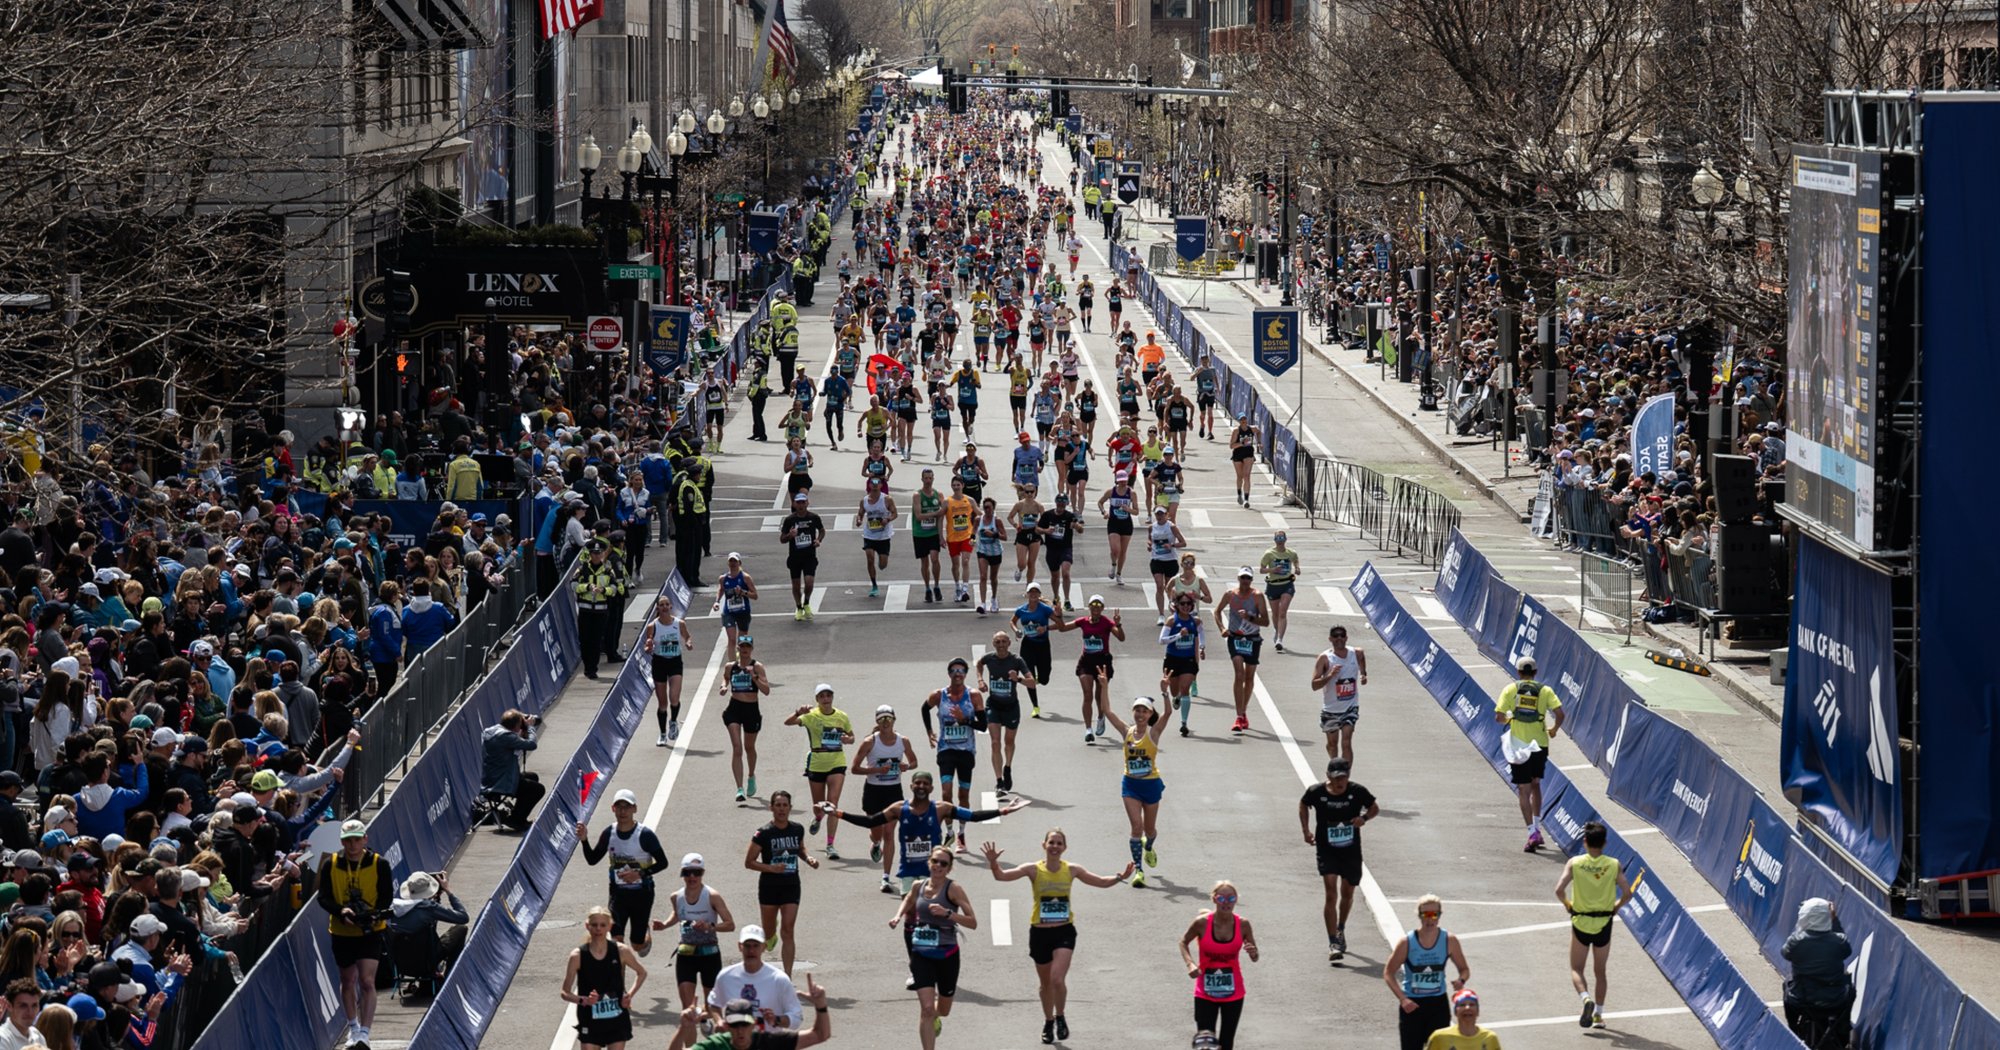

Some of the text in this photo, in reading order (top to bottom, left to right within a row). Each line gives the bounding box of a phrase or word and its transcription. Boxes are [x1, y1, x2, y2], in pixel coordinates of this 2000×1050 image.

[620, 268, 648, 278] EXETER
[467, 273, 560, 293] LENOX
[494, 295, 533, 307] HOTEL
[771, 836, 799, 850] PINOLE
